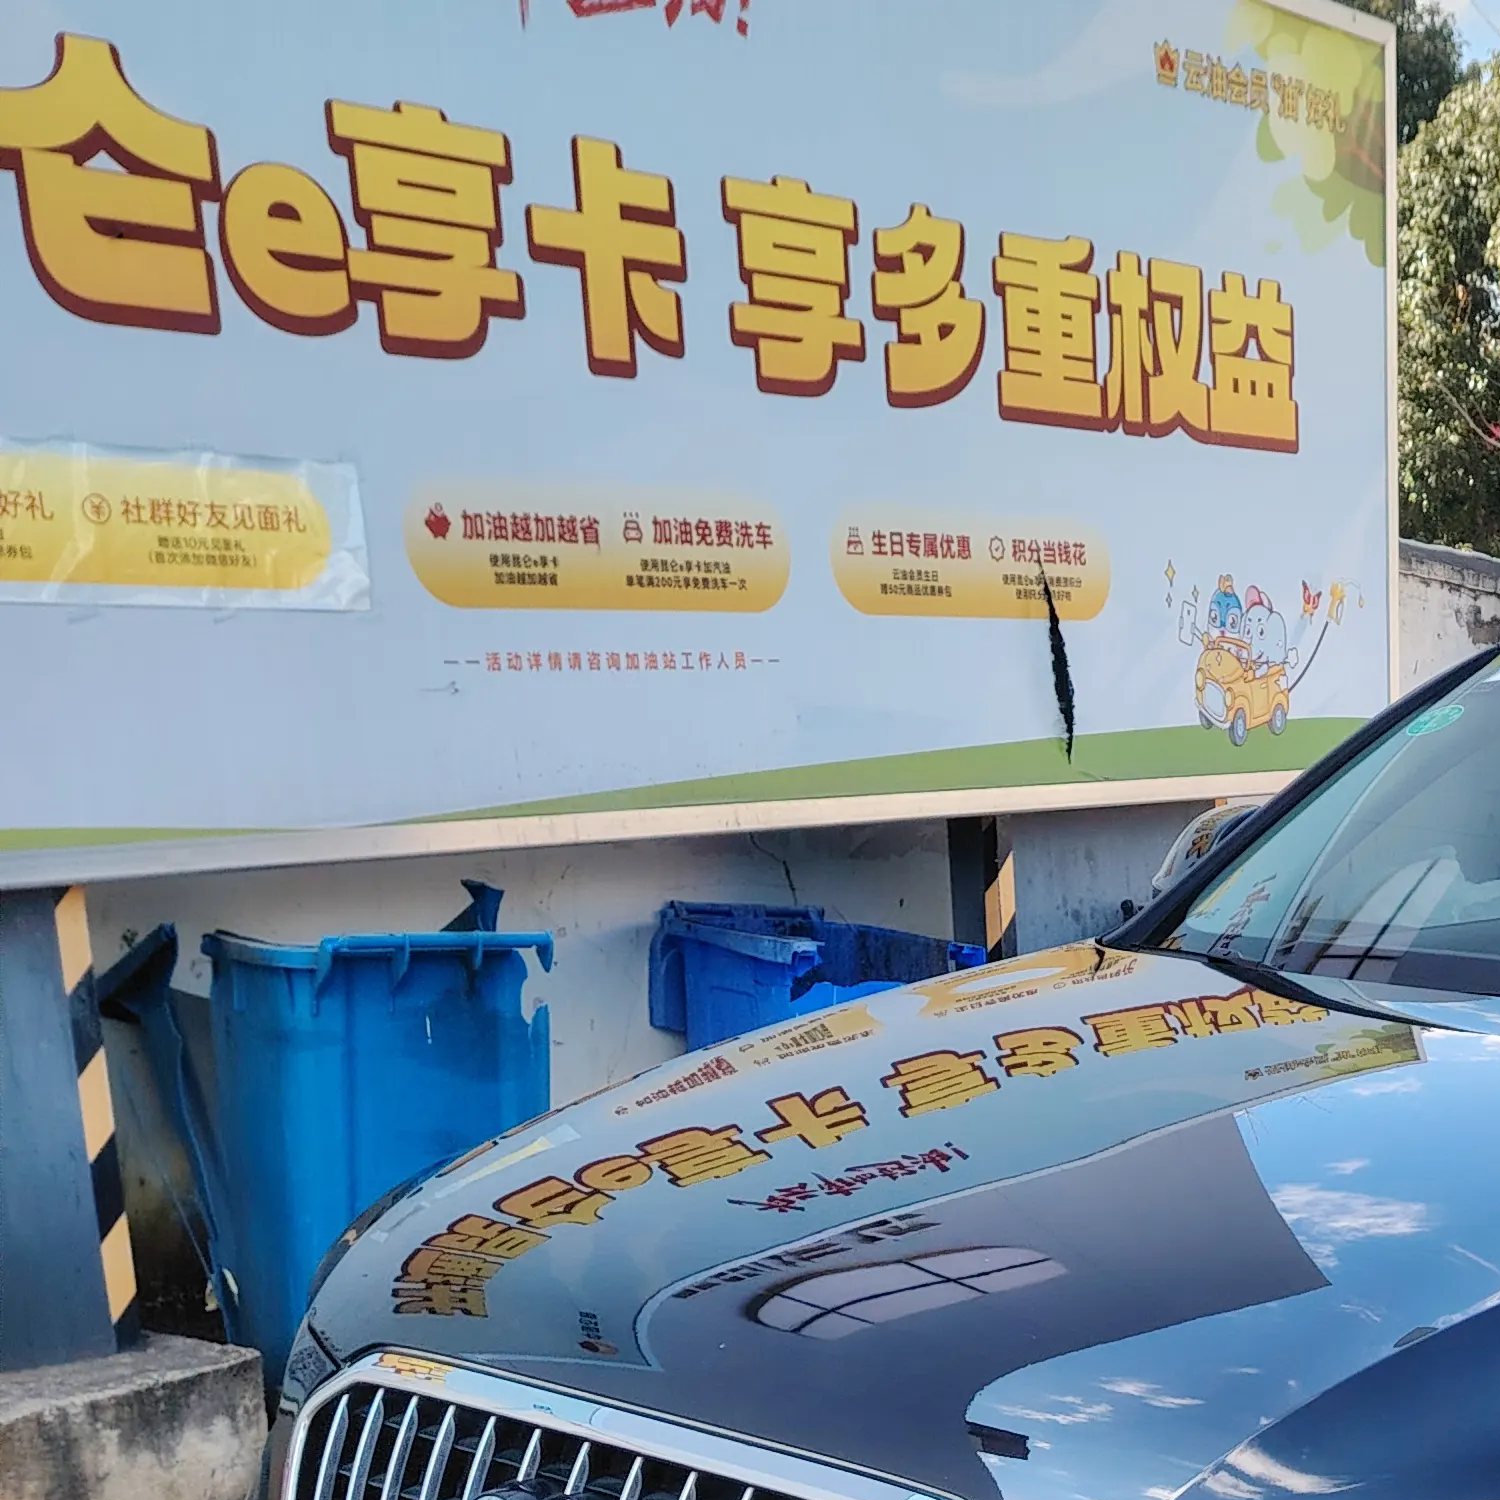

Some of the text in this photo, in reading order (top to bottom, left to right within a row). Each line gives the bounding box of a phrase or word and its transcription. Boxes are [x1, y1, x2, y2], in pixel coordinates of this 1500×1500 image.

[721, 175, 1298, 453] 享多重权益
[121, 495, 306, 533] 社群好友见面礼
[461, 509, 600, 544] 加油越加越省
[652, 515, 773, 549] 加油免费洗车
[871, 530, 972, 560] 生日专属优惠
[1012, 539, 1087, 566] 积分当钱花
